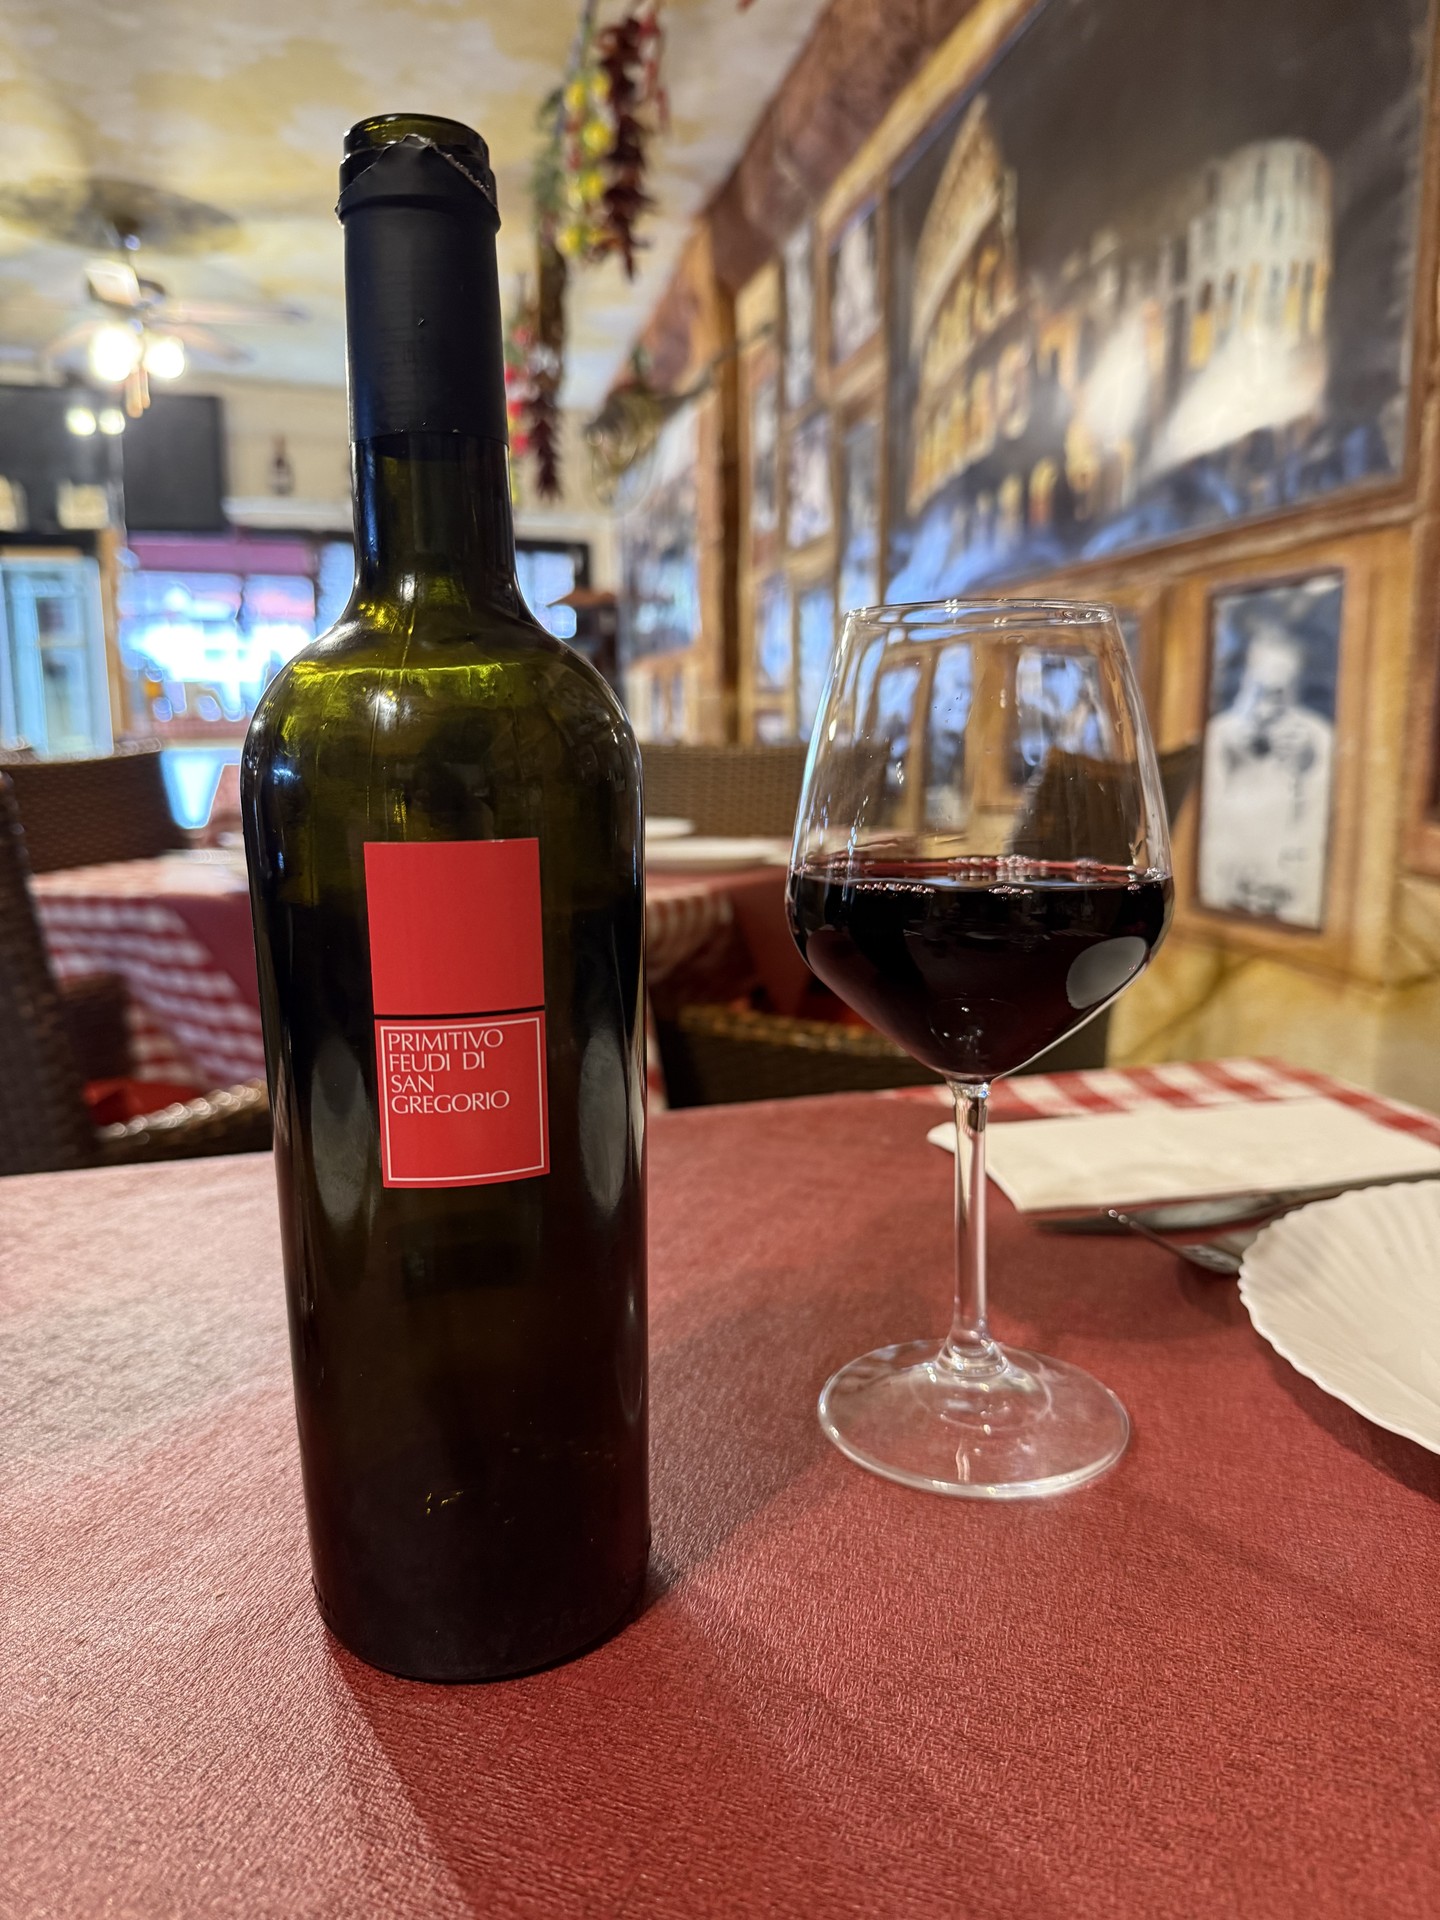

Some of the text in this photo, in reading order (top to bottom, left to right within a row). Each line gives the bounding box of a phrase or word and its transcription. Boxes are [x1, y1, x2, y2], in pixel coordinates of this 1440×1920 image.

[388, 1028, 503, 1051] PRIMITIVO
[389, 1051, 485, 1072] FEUDI DI
[391, 1074, 435, 1093] SAN
[391, 1090, 510, 1114] GREGORIO
